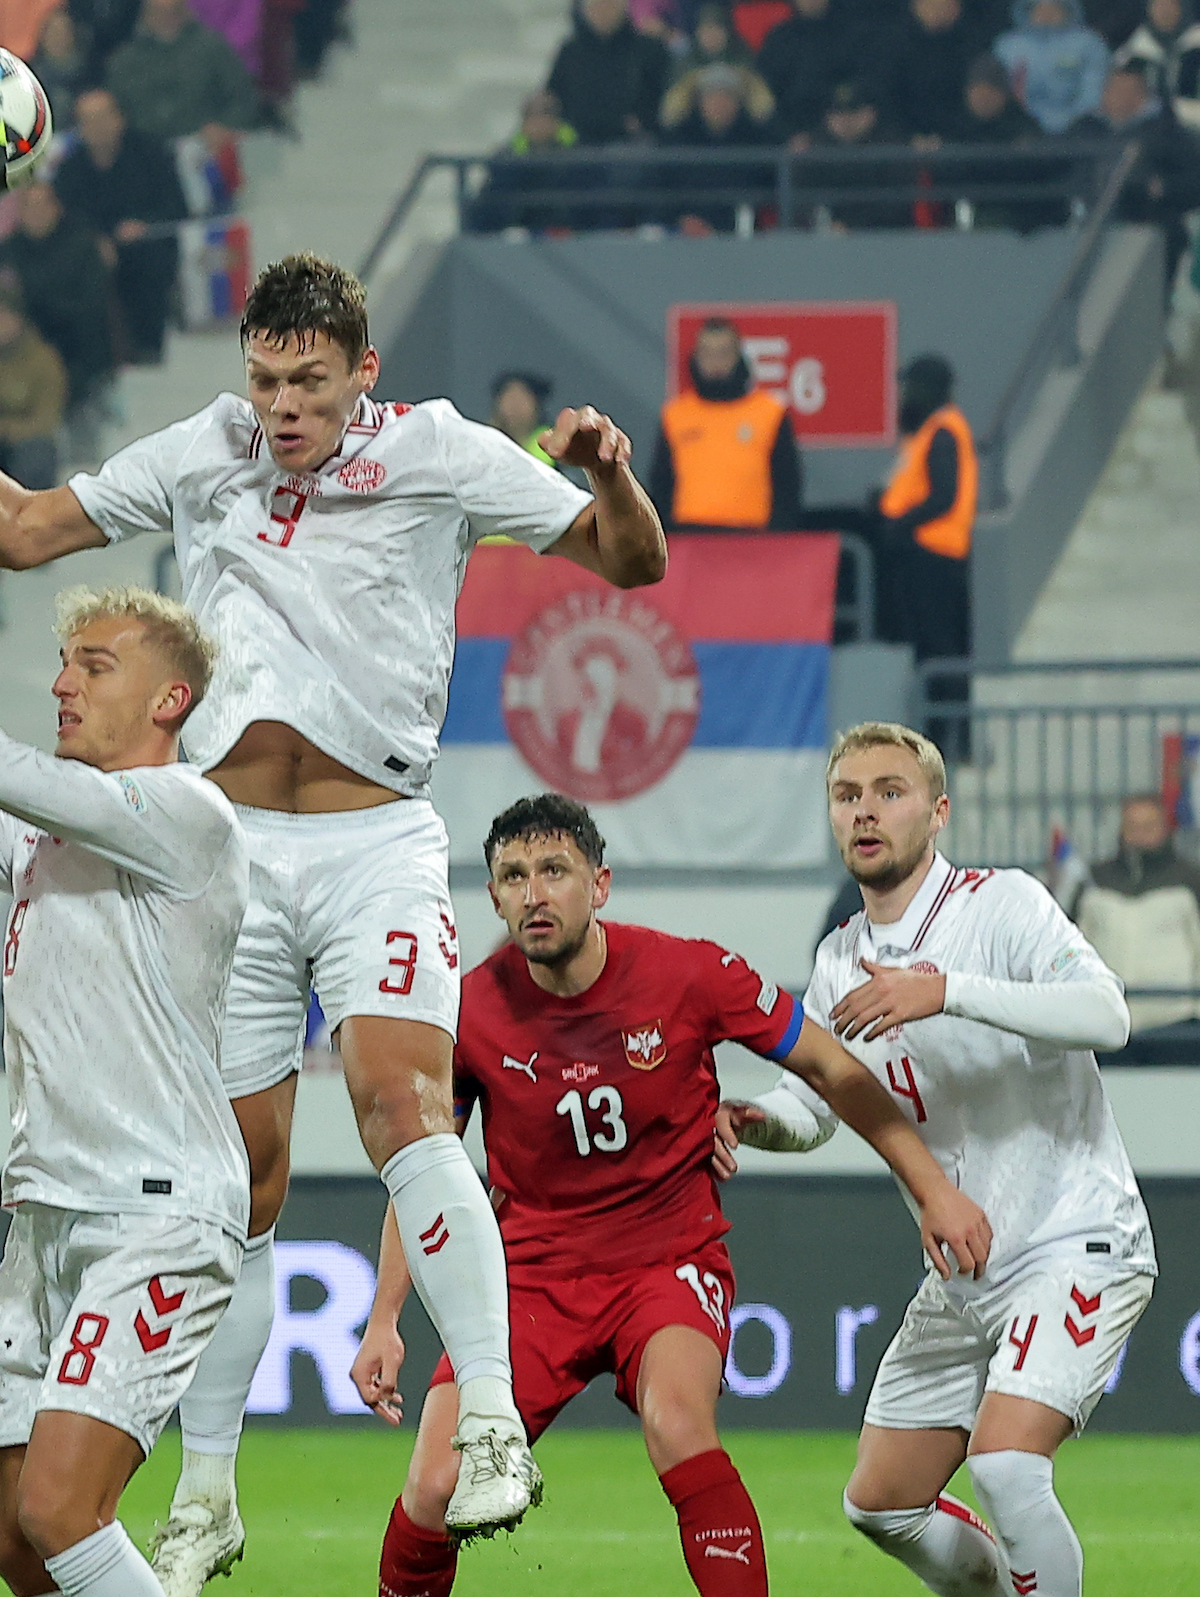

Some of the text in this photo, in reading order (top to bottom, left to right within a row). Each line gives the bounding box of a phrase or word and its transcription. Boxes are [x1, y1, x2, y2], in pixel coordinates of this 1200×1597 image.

[257, 486, 308, 548] 3
[4, 899, 30, 976] 8
[379, 930, 418, 995] 3
[555, 1085, 628, 1157] 13
[886, 1056, 927, 1124] 4
[57, 1312, 110, 1386] 8
[1009, 1313, 1040, 1372] 4
